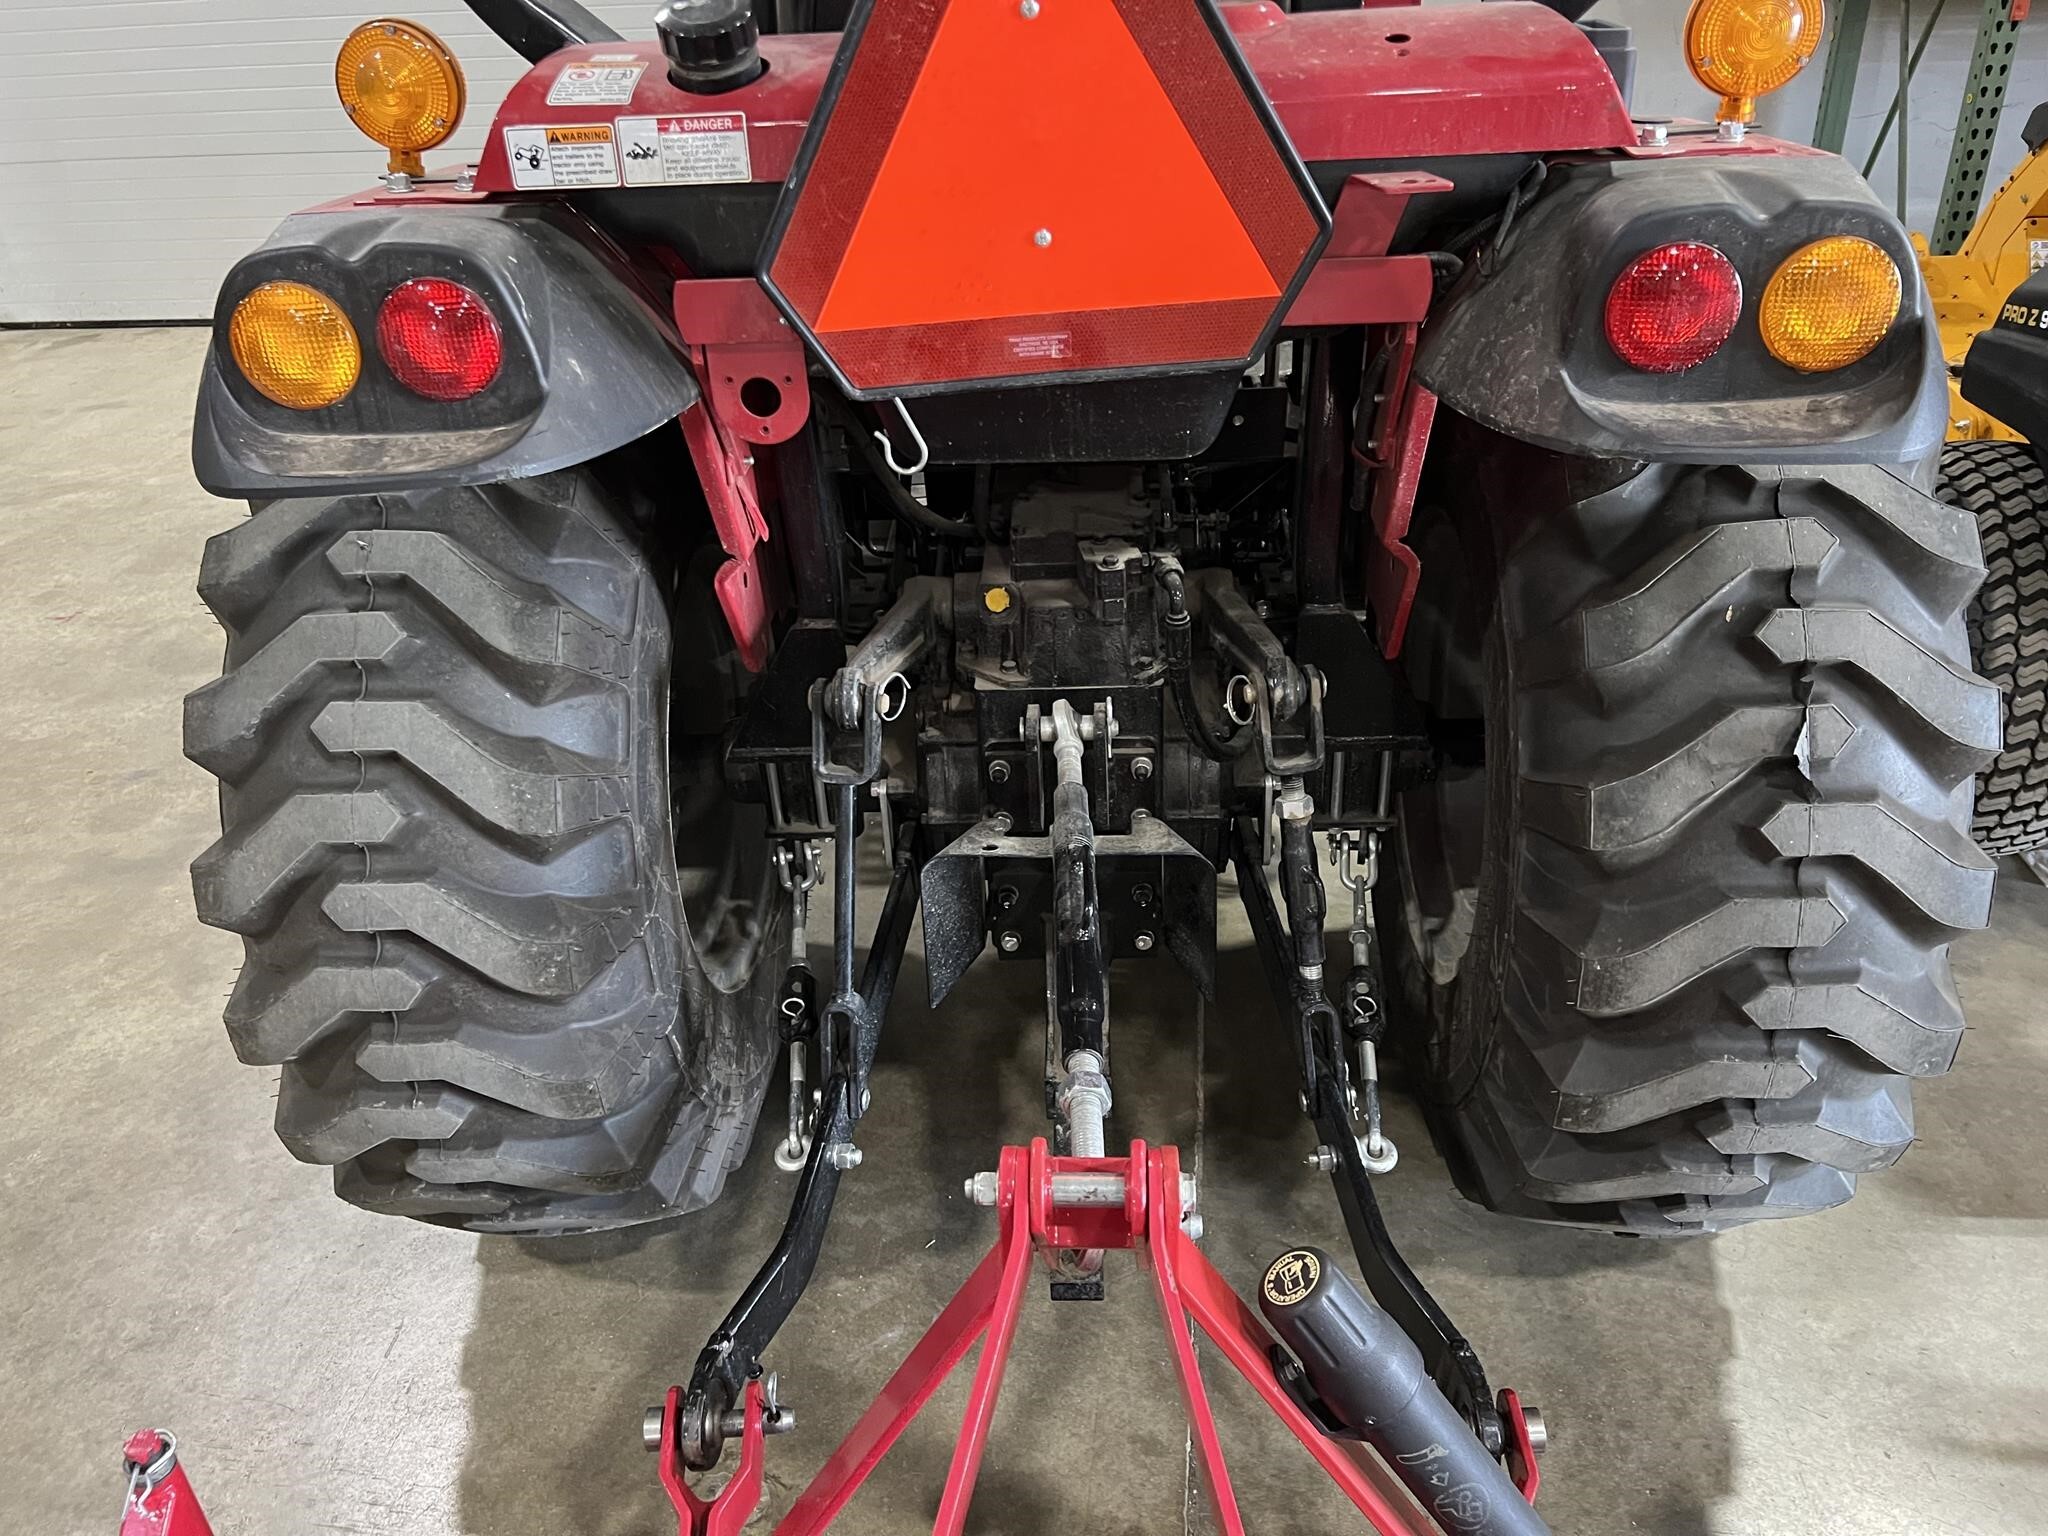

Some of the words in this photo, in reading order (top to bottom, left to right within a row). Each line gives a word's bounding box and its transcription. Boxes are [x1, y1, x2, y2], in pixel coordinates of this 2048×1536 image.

[683, 118, 733, 131] DANGER
[561, 130, 609, 141] WARNING
[2002, 303, 2028, 325] PRO
[2027, 308, 2040, 327] Z
[1267, 1255, 1295, 1281] MANUAL
